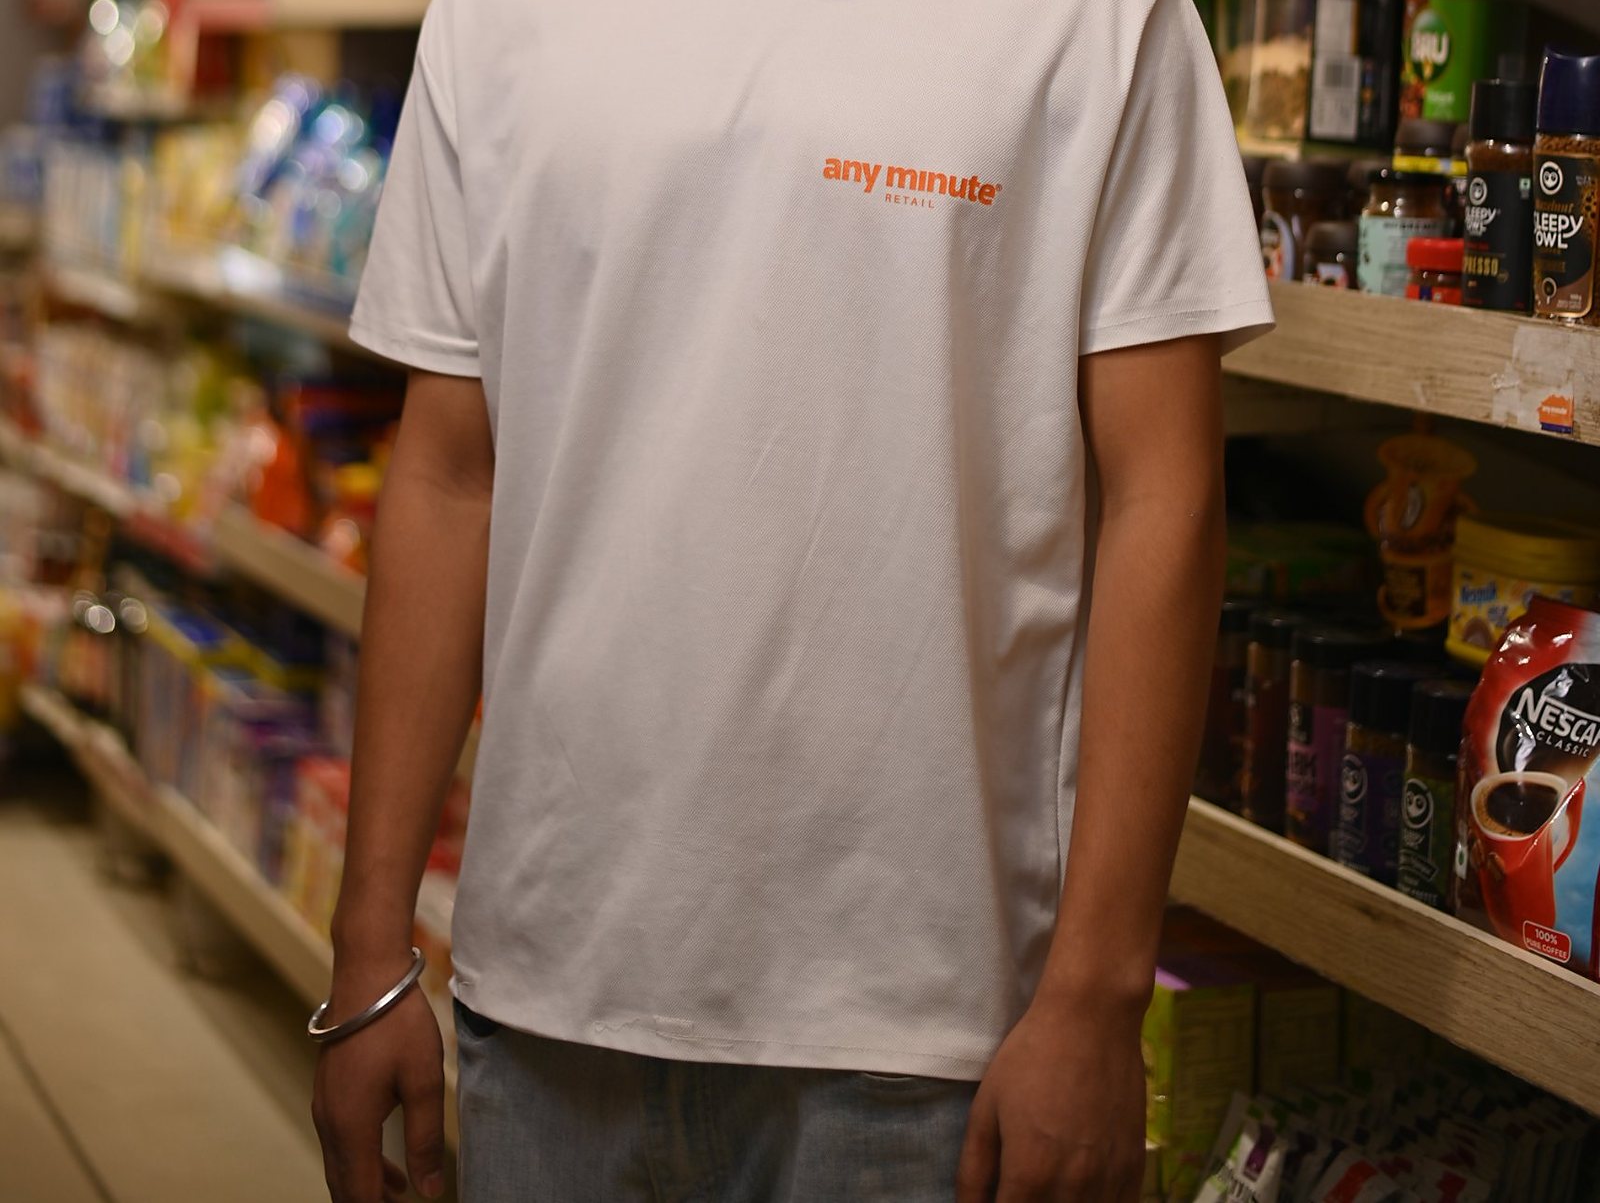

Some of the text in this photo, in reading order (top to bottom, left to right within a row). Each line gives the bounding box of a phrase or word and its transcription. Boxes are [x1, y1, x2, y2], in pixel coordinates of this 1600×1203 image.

[823, 158, 881, 193] any
[885, 193, 935, 209] RETAIL
[1536, 230, 1569, 249] OWL
[1536, 730, 1590, 758] CLASSIC
[1535, 928, 1558, 945] 100%
[1542, 944, 1568, 959] COFFEE
